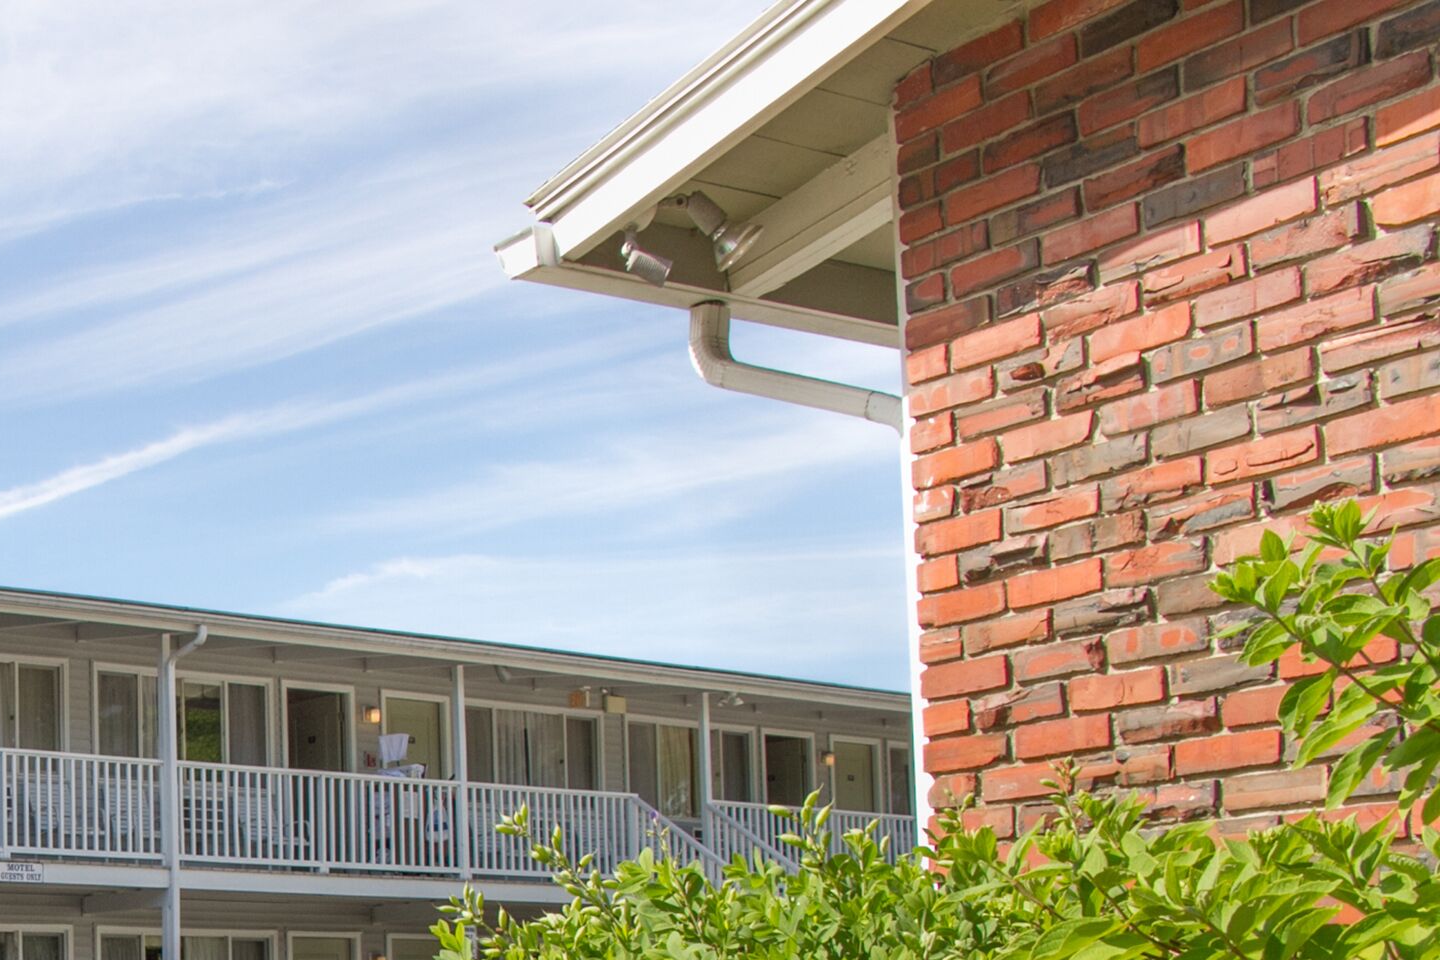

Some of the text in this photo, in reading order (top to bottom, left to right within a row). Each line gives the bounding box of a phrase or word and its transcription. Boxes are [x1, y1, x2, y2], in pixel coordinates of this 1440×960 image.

[7, 863, 35, 872] MOTEL
[0, 872, 42, 881] GUESTS ONLY
